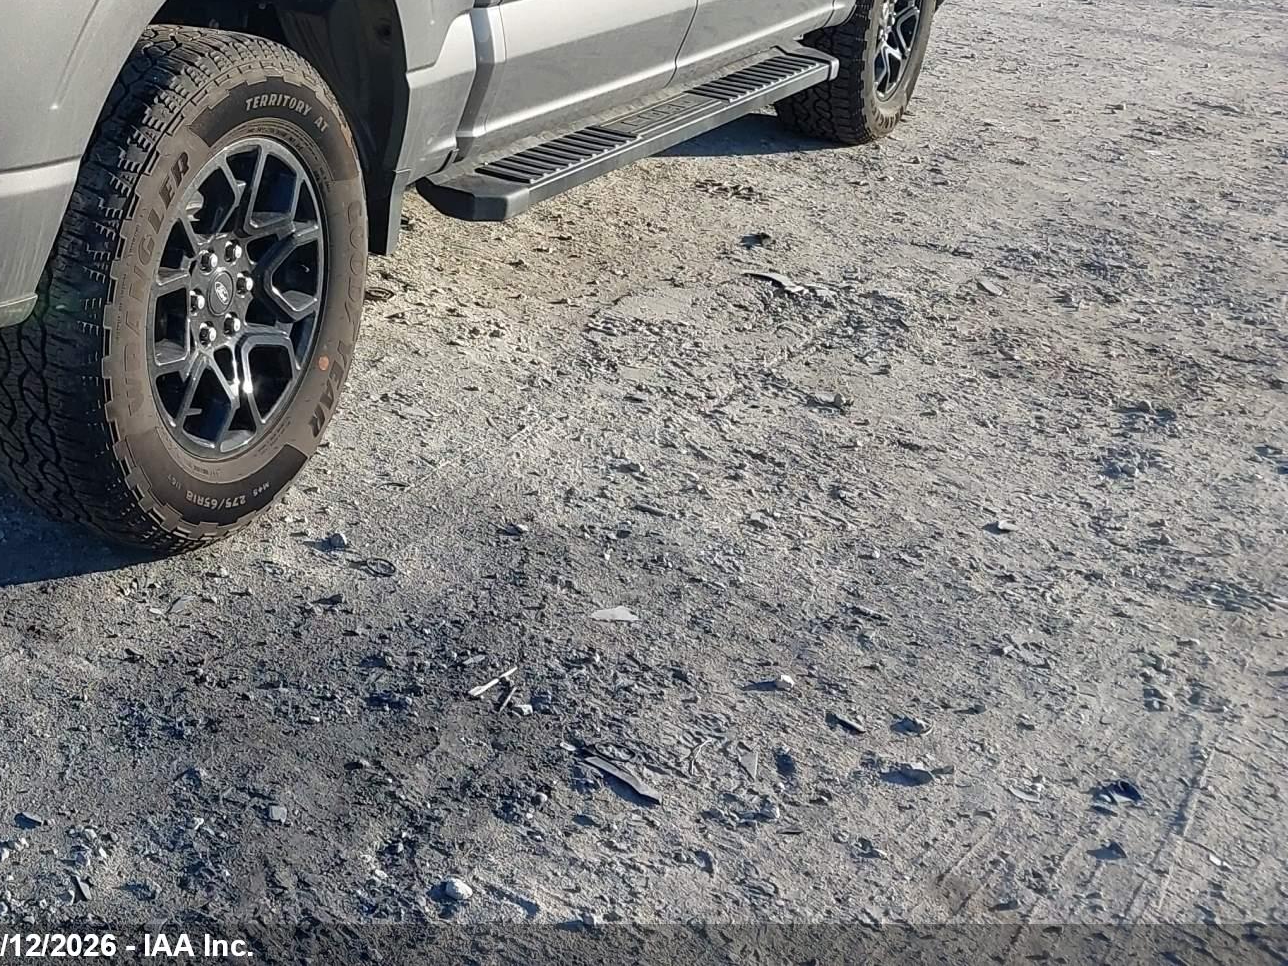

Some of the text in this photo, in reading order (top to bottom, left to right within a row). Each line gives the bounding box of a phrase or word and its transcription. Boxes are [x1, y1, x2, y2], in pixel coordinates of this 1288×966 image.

[245, 93, 329, 134] TERRITORY AT
[121, 150, 192, 418] WRANGLER
